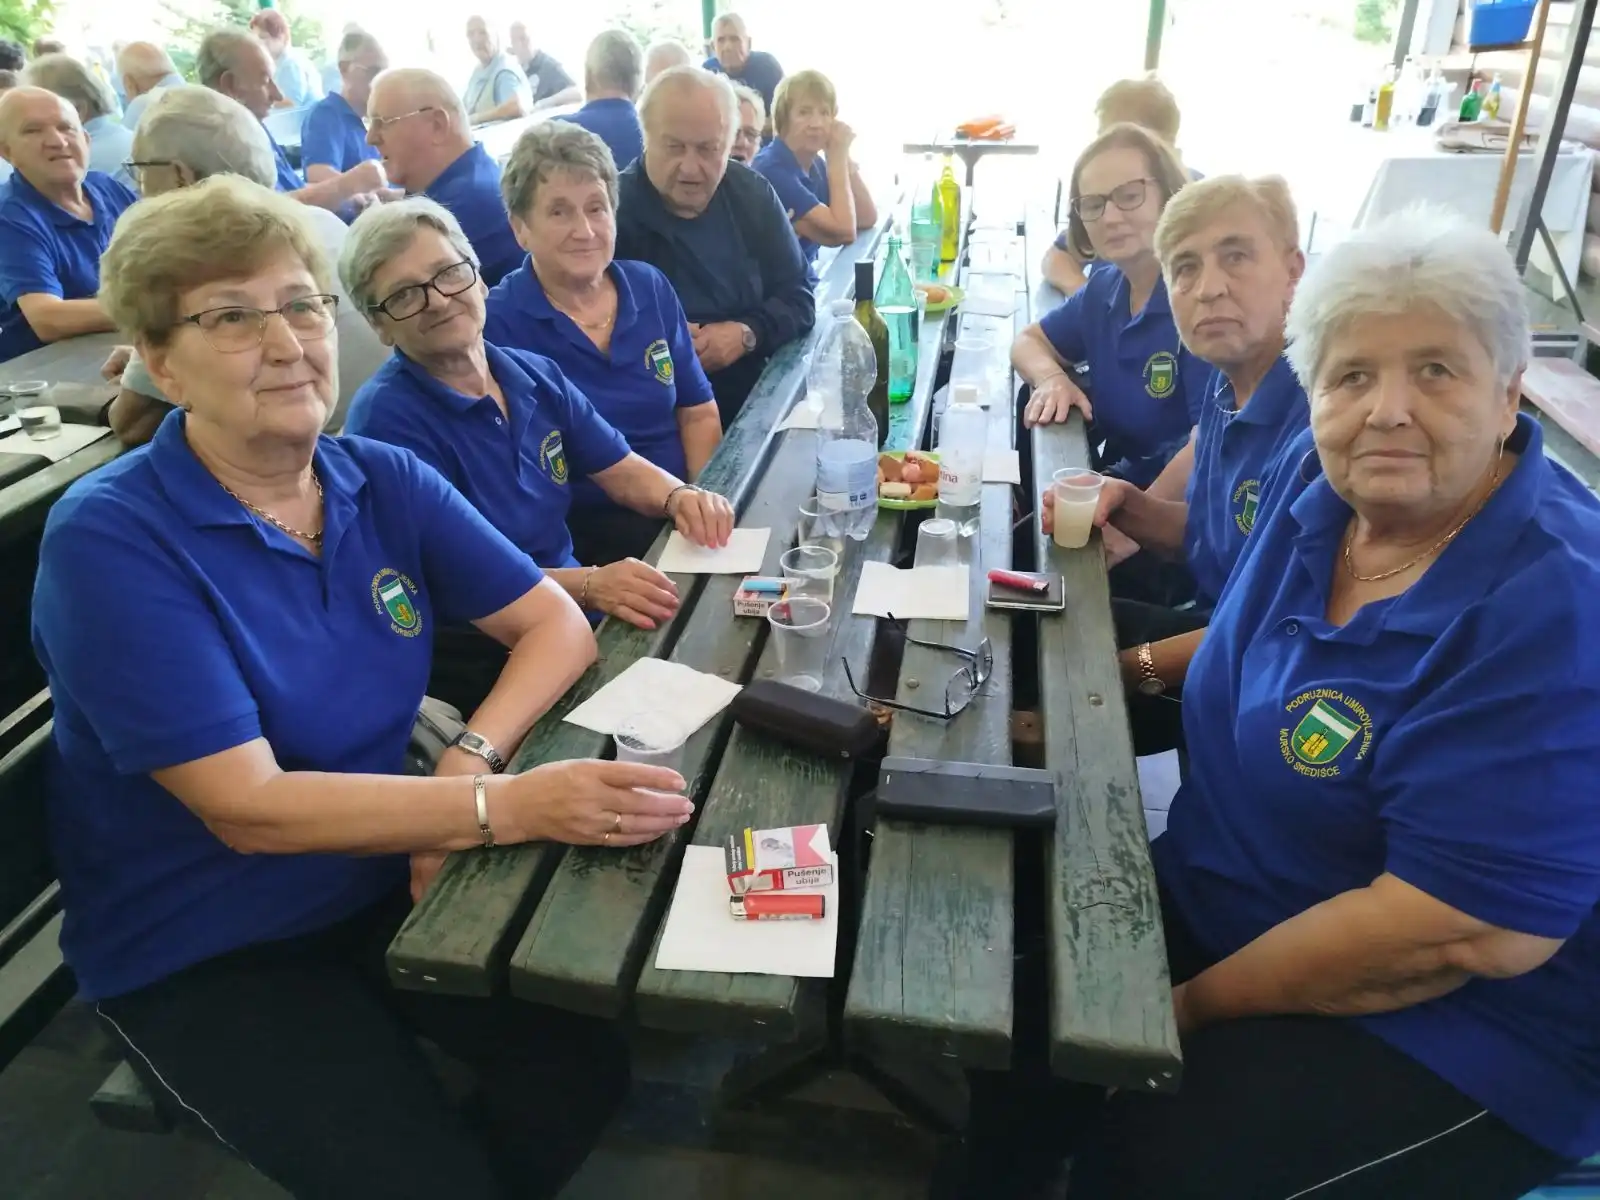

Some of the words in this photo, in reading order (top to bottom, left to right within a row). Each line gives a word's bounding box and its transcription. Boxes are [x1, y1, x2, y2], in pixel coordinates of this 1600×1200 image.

[1343, 695, 1373, 760] UMIROVLJENIKA
[1279, 728, 1295, 764] MURSKO
[787, 868, 827, 878] Pušenje
[795, 876, 820, 885] ubija
